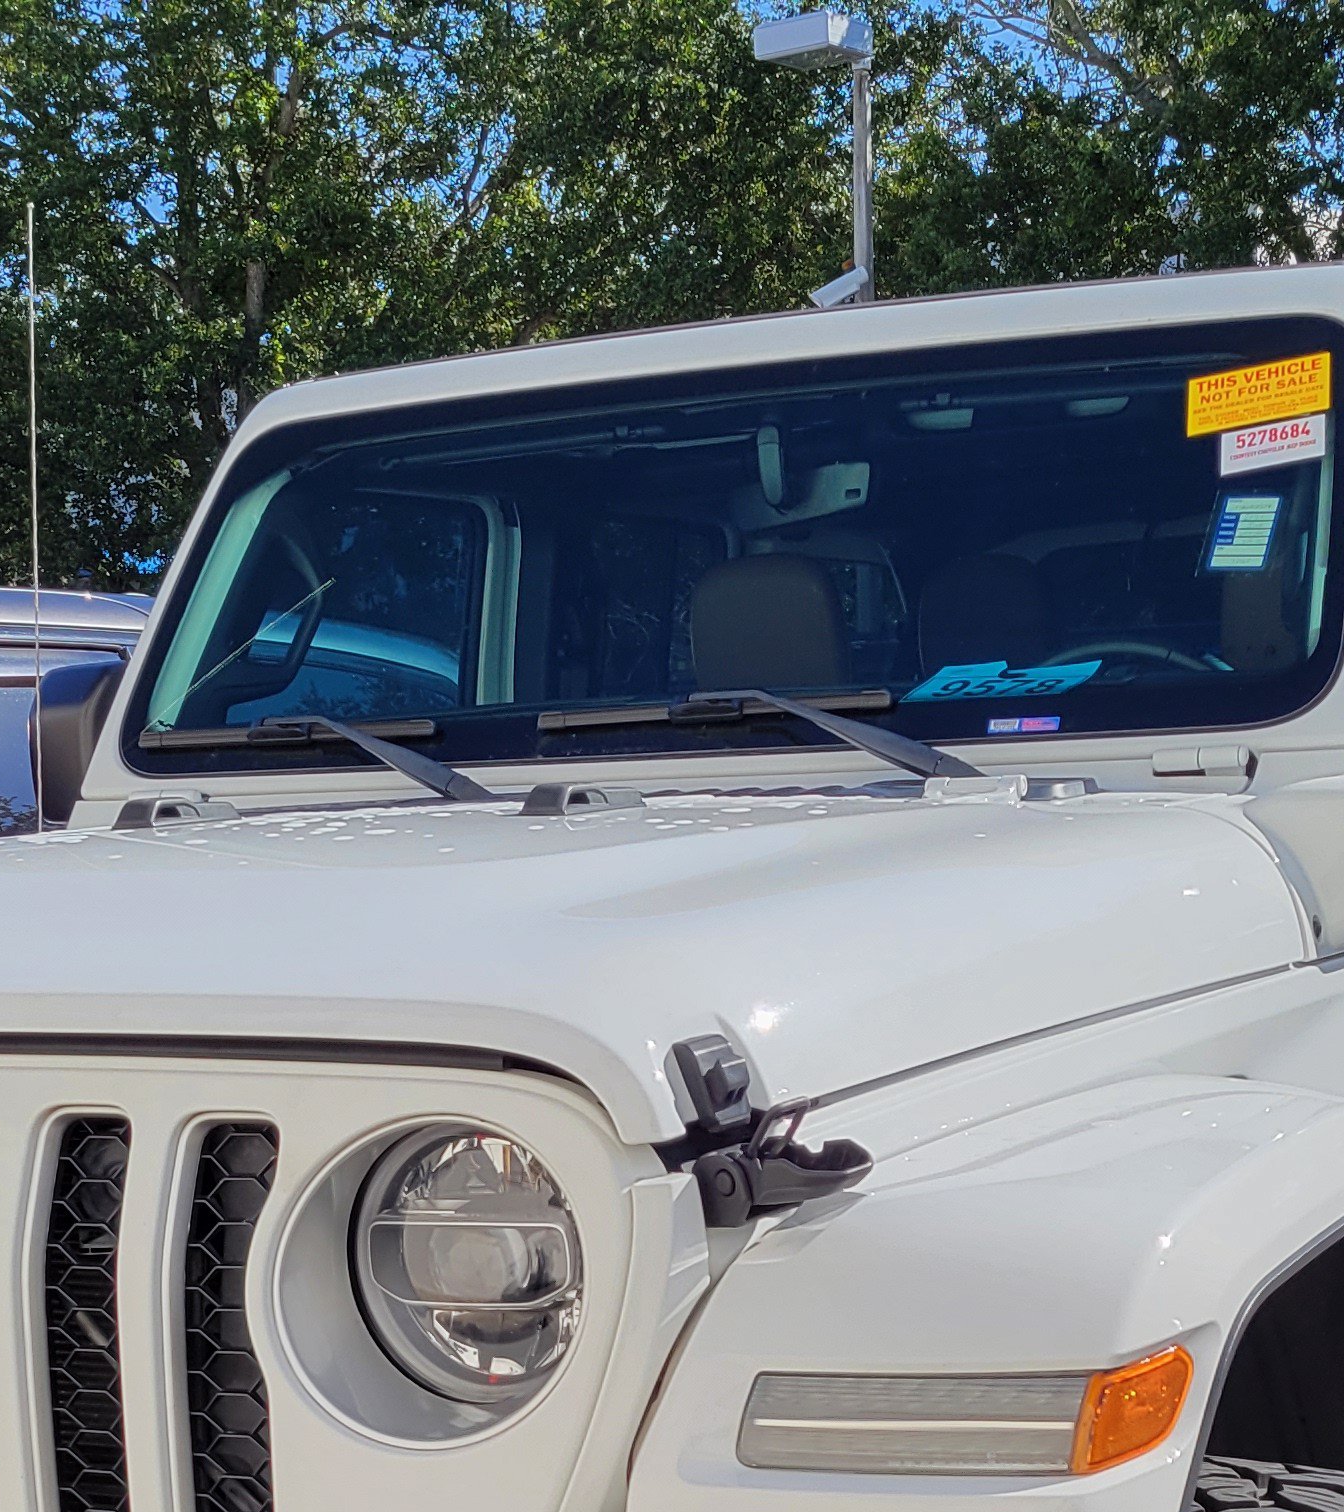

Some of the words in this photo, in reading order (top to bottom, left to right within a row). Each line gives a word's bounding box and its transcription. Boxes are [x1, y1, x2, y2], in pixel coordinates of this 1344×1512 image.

[1197, 376, 1236, 393] THIS
[1243, 358, 1322, 383] VEHICLE
[1200, 390, 1233, 404] NOT
[1238, 383, 1270, 397] FOR
[1276, 373, 1318, 389] SALE
[1236, 421, 1310, 449] 5278684
[931, 678, 1065, 698] 9578
